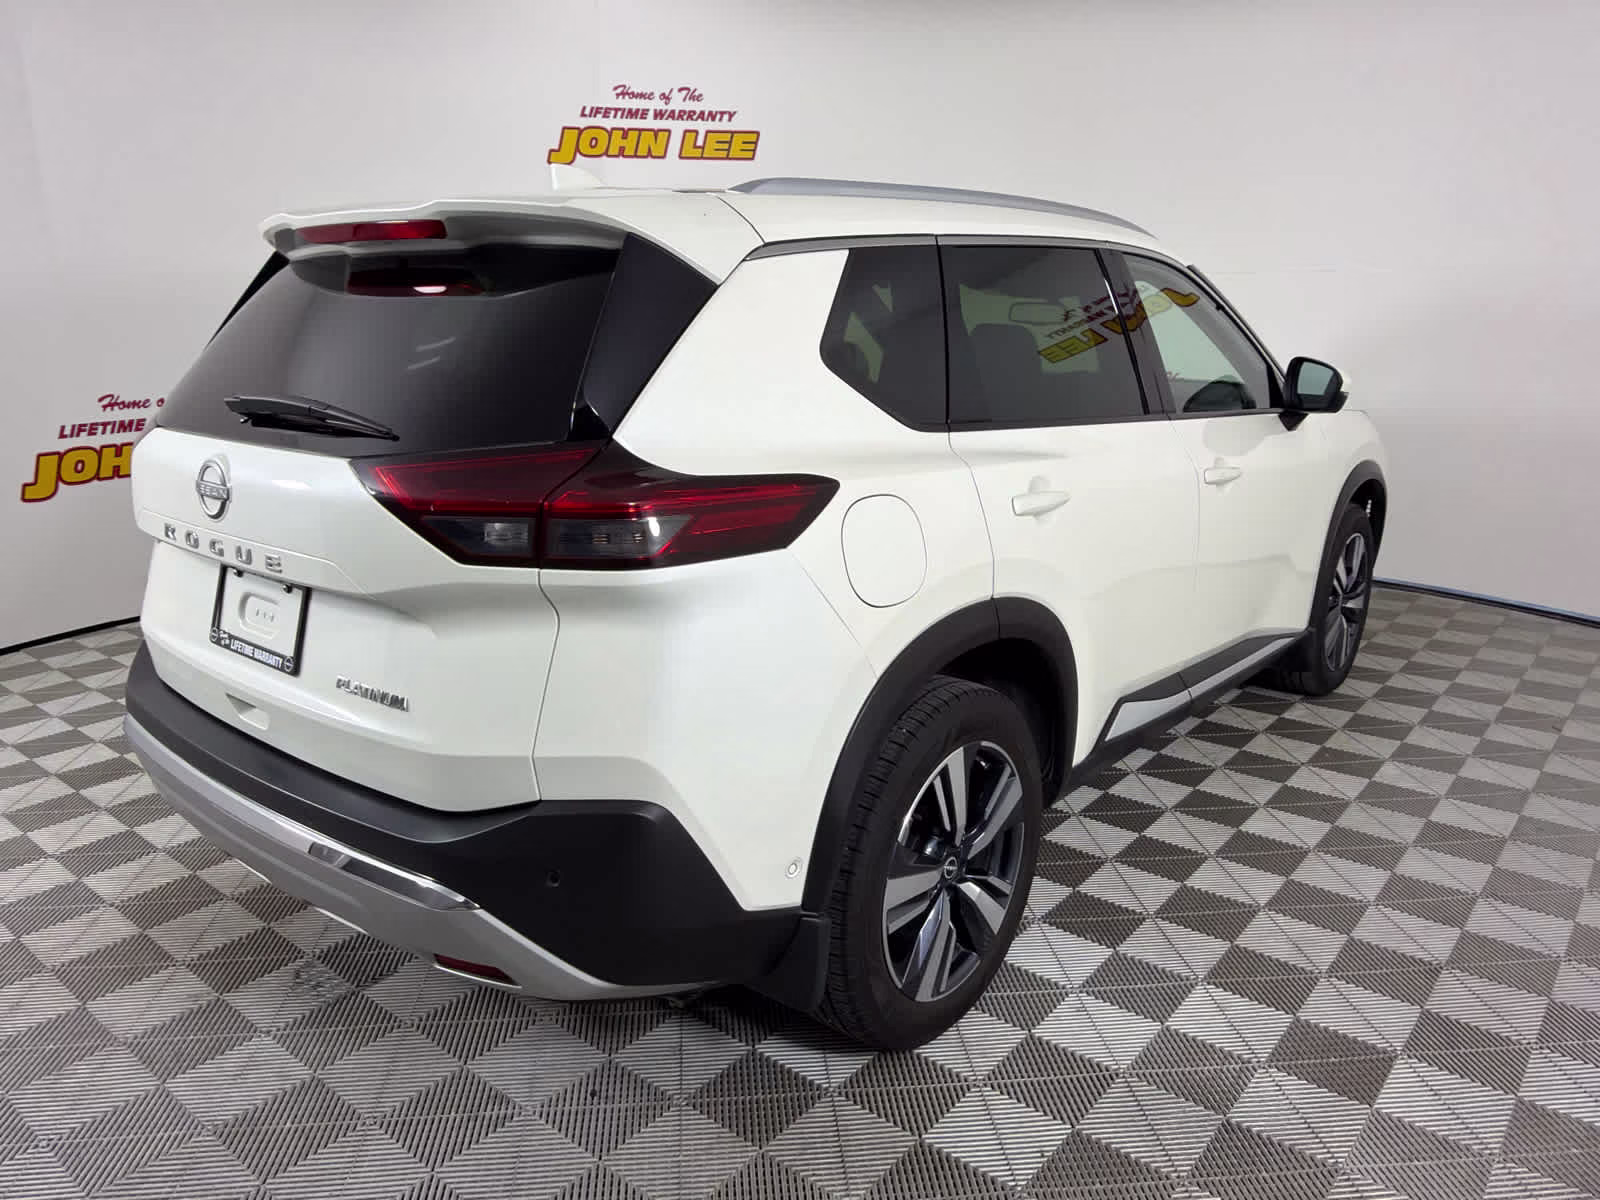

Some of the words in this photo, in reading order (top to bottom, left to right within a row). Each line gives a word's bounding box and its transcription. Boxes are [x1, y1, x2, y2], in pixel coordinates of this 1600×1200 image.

[612, 84, 655, 102] Home
[659, 88, 674, 106] of
[677, 87, 704, 103] The
[580, 105, 650, 121] LIFETIME
[652, 108, 737, 123] WARRANTY
[547, 126, 671, 165] JOHN
[678, 129, 761, 161] LEE
[97, 394, 153, 412] Home
[156, 397, 166, 408] o
[58, 418, 147, 439] LIFETIME
[21, 442, 134, 503] JOH
[163, 523, 283, 574] ROGUE
[335, 675, 410, 712] PLATINUM
